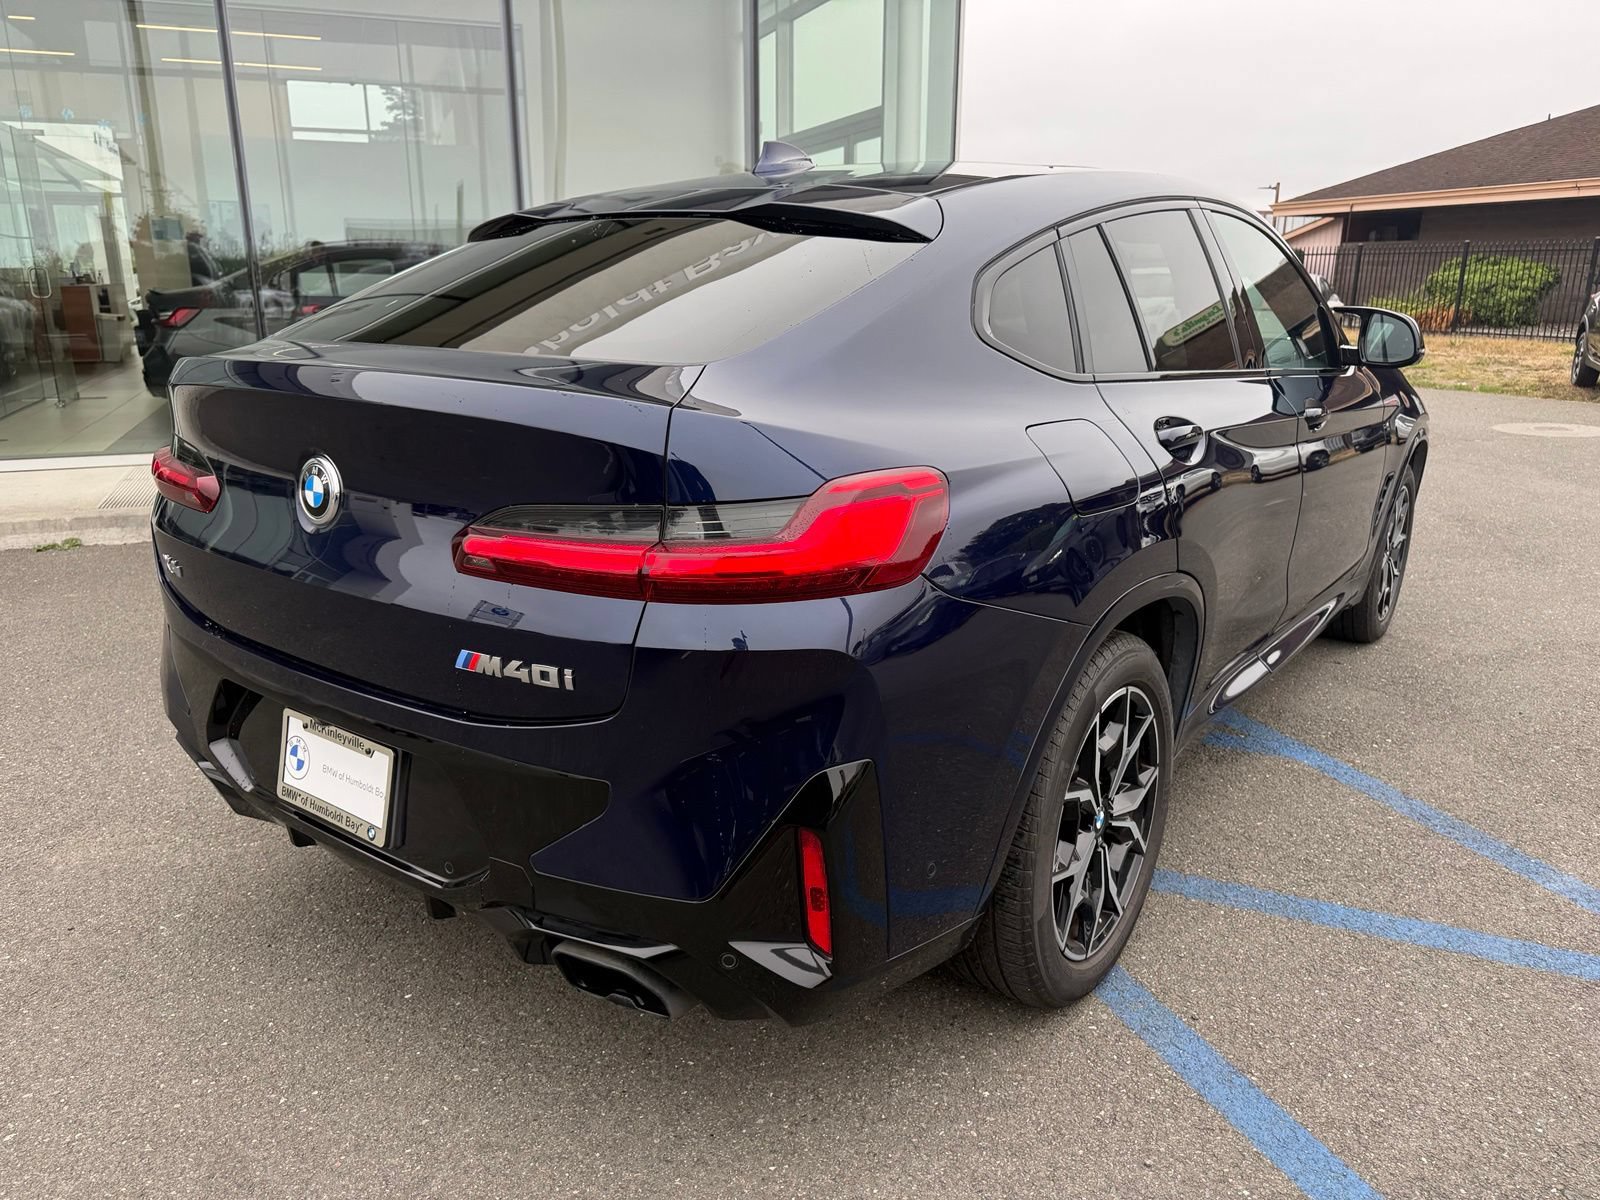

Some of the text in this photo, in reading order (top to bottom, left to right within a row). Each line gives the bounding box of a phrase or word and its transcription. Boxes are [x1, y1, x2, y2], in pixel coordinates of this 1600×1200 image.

[474, 652, 575, 691] M40i
[310, 718, 365, 751] McKinleyville
[322, 764, 339, 778] BMW
[338, 772, 345, 781] of
[345, 774, 374, 794] Humboldt
[300, 796, 309, 807] of
[309, 799, 345, 823] Humboldt
